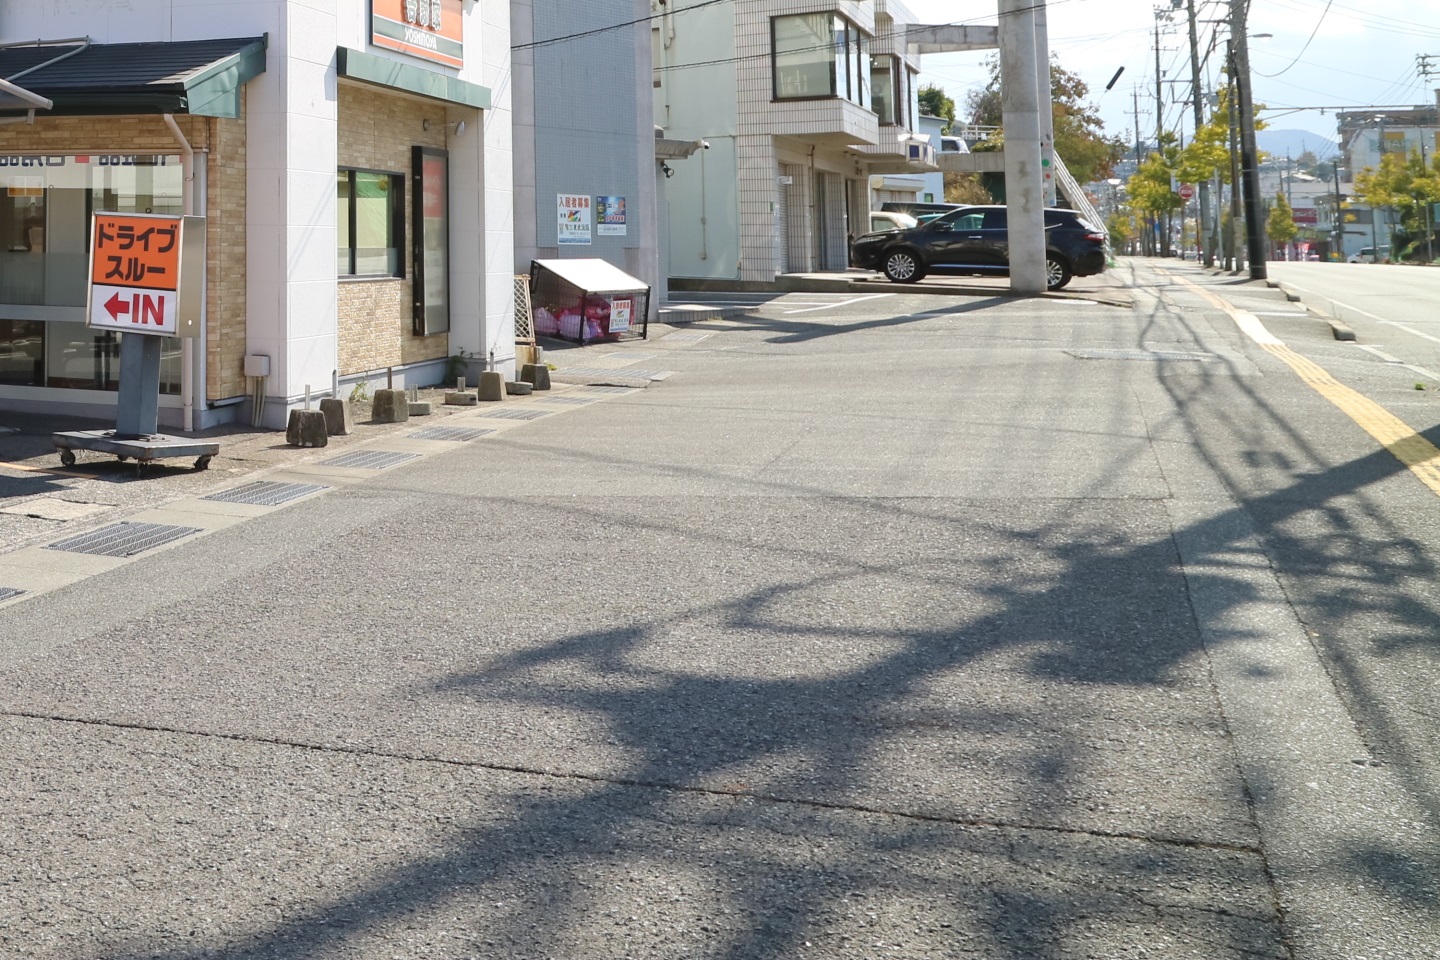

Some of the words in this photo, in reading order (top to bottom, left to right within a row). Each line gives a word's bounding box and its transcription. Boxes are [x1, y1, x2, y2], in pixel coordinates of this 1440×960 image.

[404, 27, 438, 50] YOSHINOYA
[98, 223, 177, 253] ドライブ
[105, 255, 166, 282] スルー
[131, 293, 165, 326] IN
